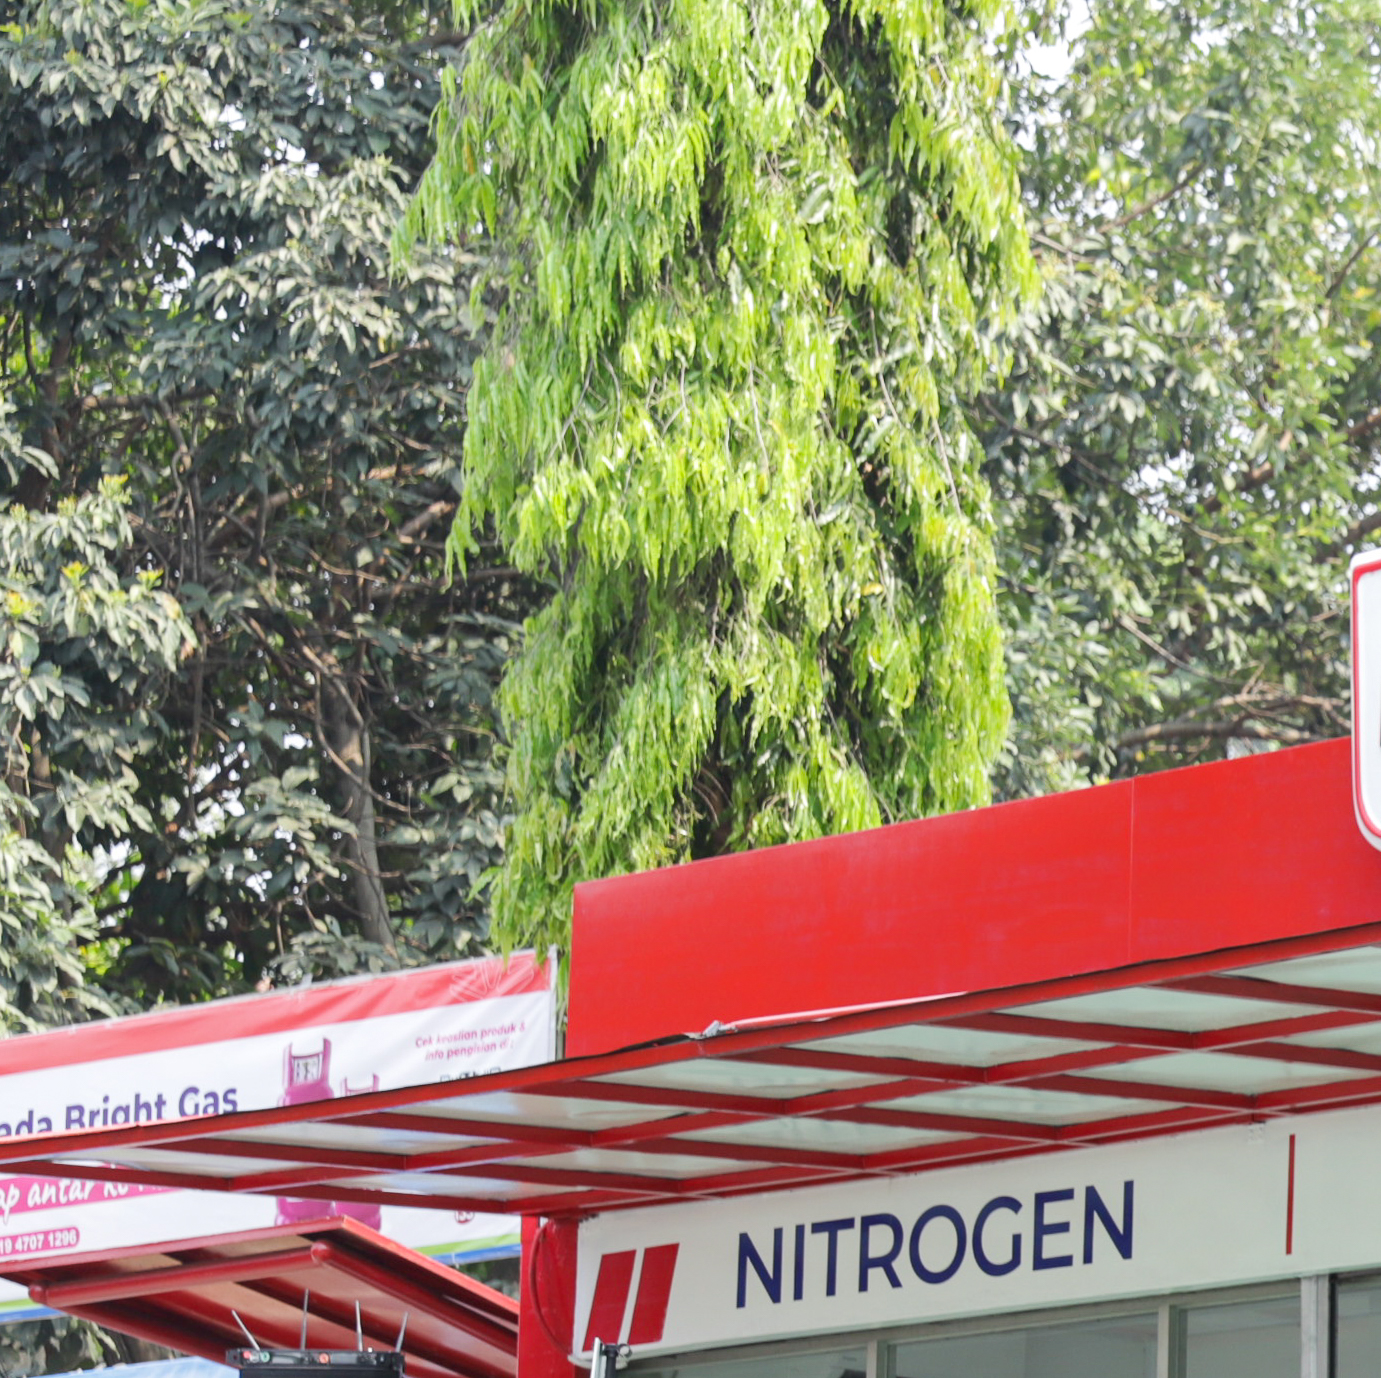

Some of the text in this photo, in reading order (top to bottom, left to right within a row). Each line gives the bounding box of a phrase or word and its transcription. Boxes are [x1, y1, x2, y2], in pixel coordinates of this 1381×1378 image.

[415, 1035, 434, 1048] Cek
[480, 1022, 516, 1041] produk
[425, 1048, 444, 1061] info
[65, 1094, 167, 1130] Bright
[179, 1086, 239, 1116] Gas
[15, 1233, 45, 1252] 4707
[736, 1180, 1135, 1309] NITROGEN
